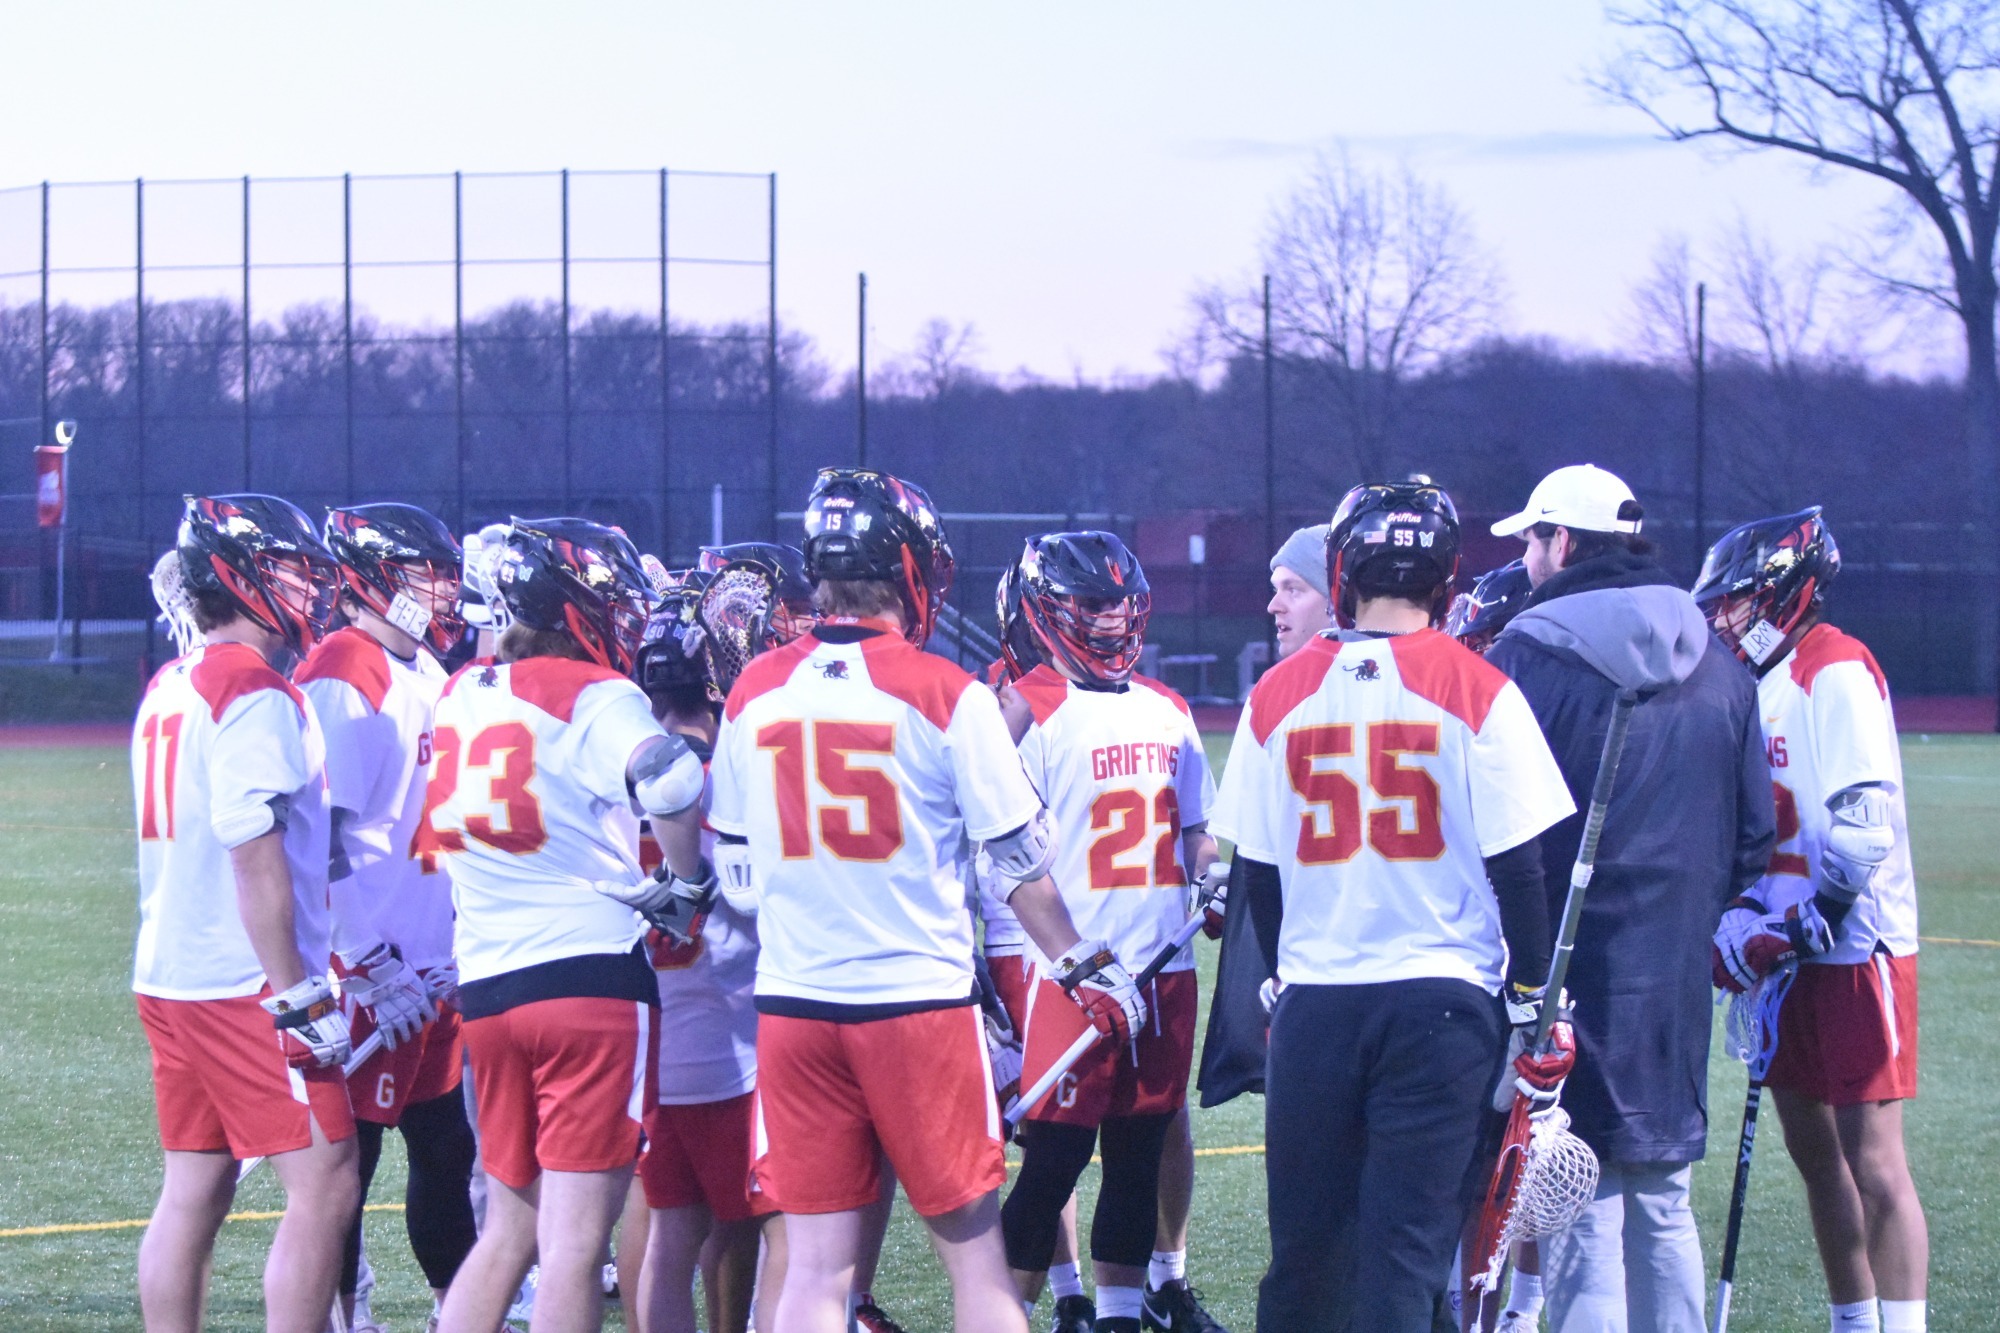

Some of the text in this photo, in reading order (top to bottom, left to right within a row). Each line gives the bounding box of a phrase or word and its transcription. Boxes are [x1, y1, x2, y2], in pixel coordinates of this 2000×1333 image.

[825, 513, 843, 530] 15
[1386, 512, 1422, 523] Griffins
[1393, 529, 1414, 547] 55
[395, 597, 430, 636] 4:13
[141, 711, 184, 842] 11
[1091, 742, 1180, 781] GRIFFINS
[409, 719, 550, 857] 23
[755, 717, 906, 863] 15
[1285, 719, 1448, 868] 55
[1088, 786, 1189, 892] 22
[376, 1072, 396, 1109] G
[1056, 1071, 1078, 1109] G
